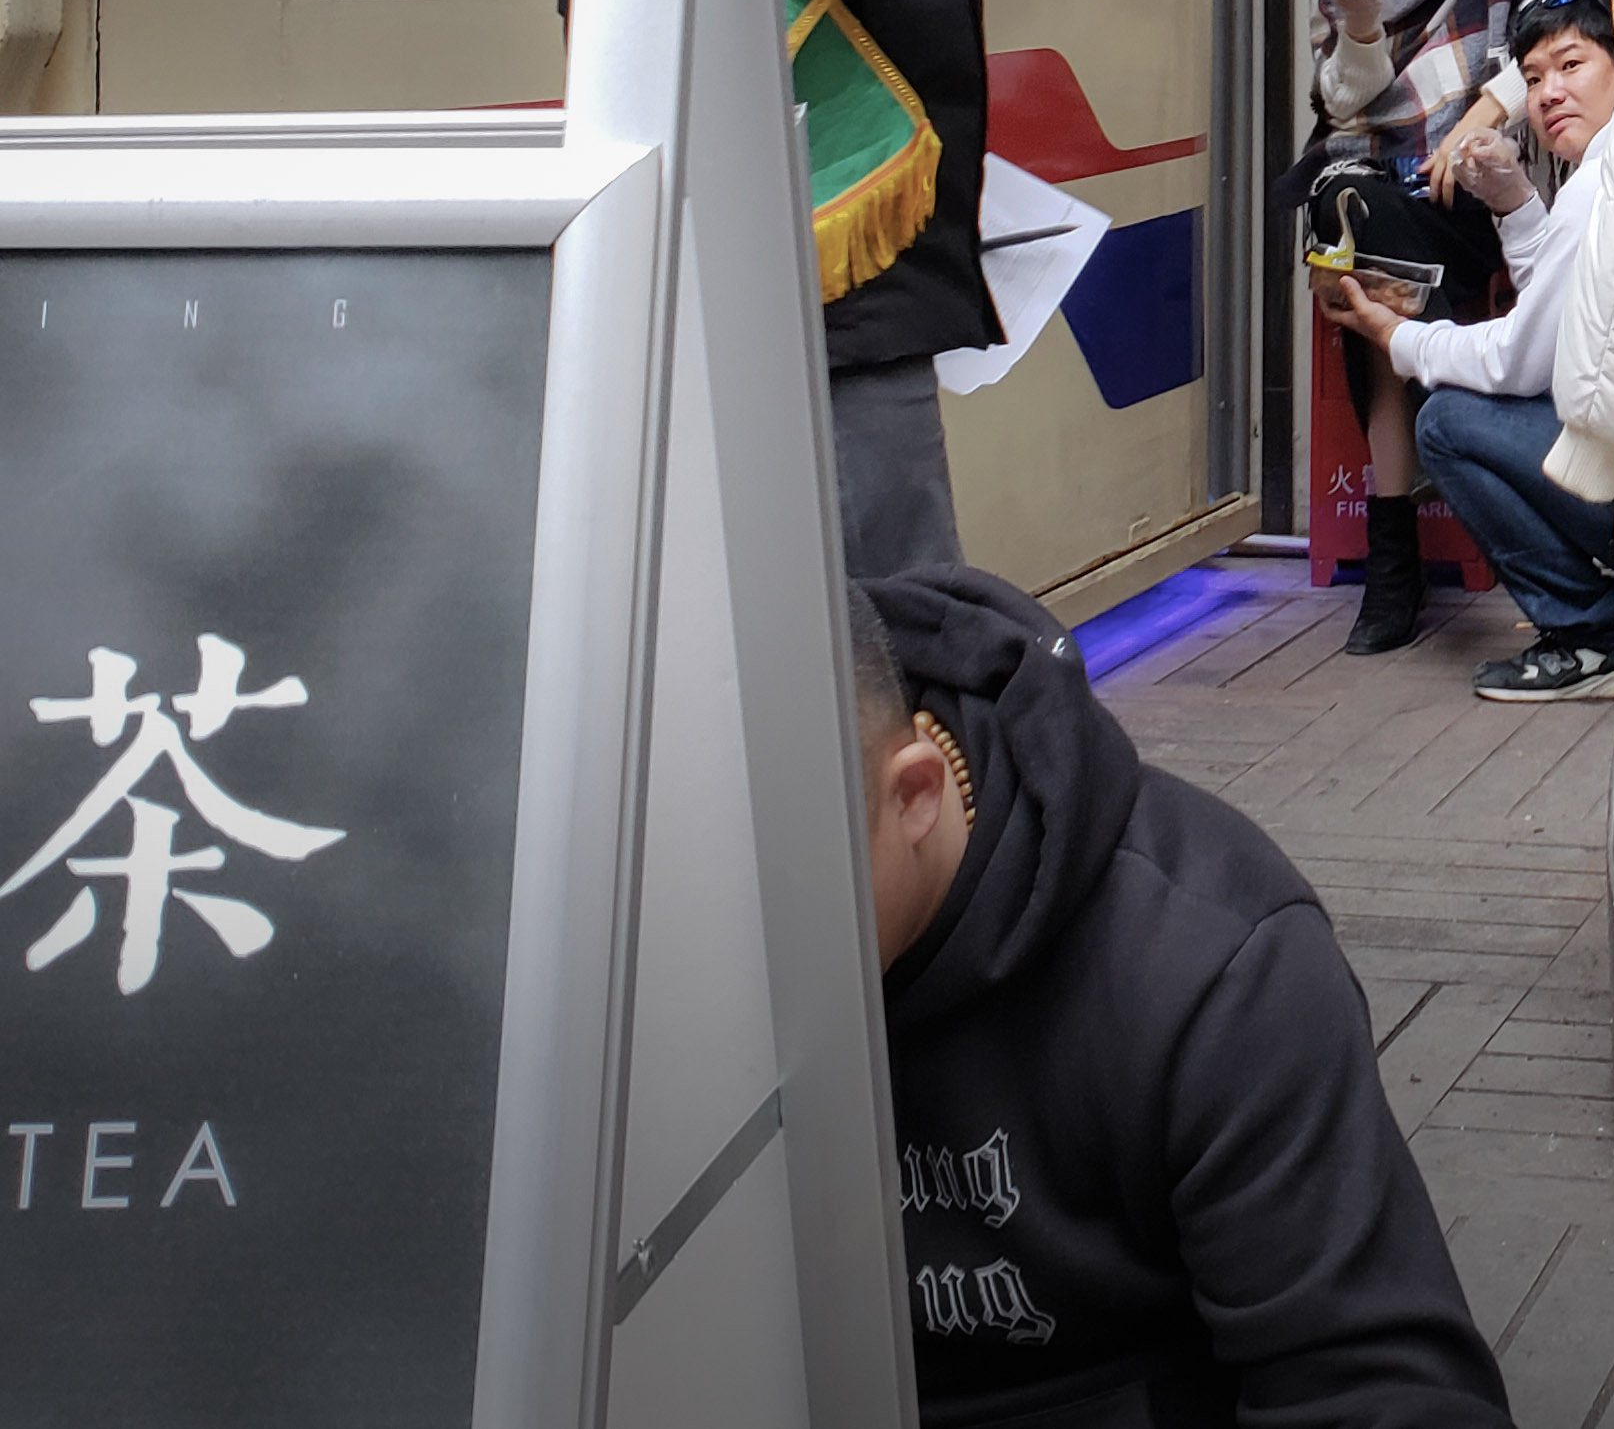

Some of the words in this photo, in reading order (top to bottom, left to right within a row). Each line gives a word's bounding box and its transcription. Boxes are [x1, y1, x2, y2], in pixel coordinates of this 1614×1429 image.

[1336, 500, 1368, 518] FIR
[0, 632, 348, 996] 茶
[8, 1121, 238, 1210] TEA
